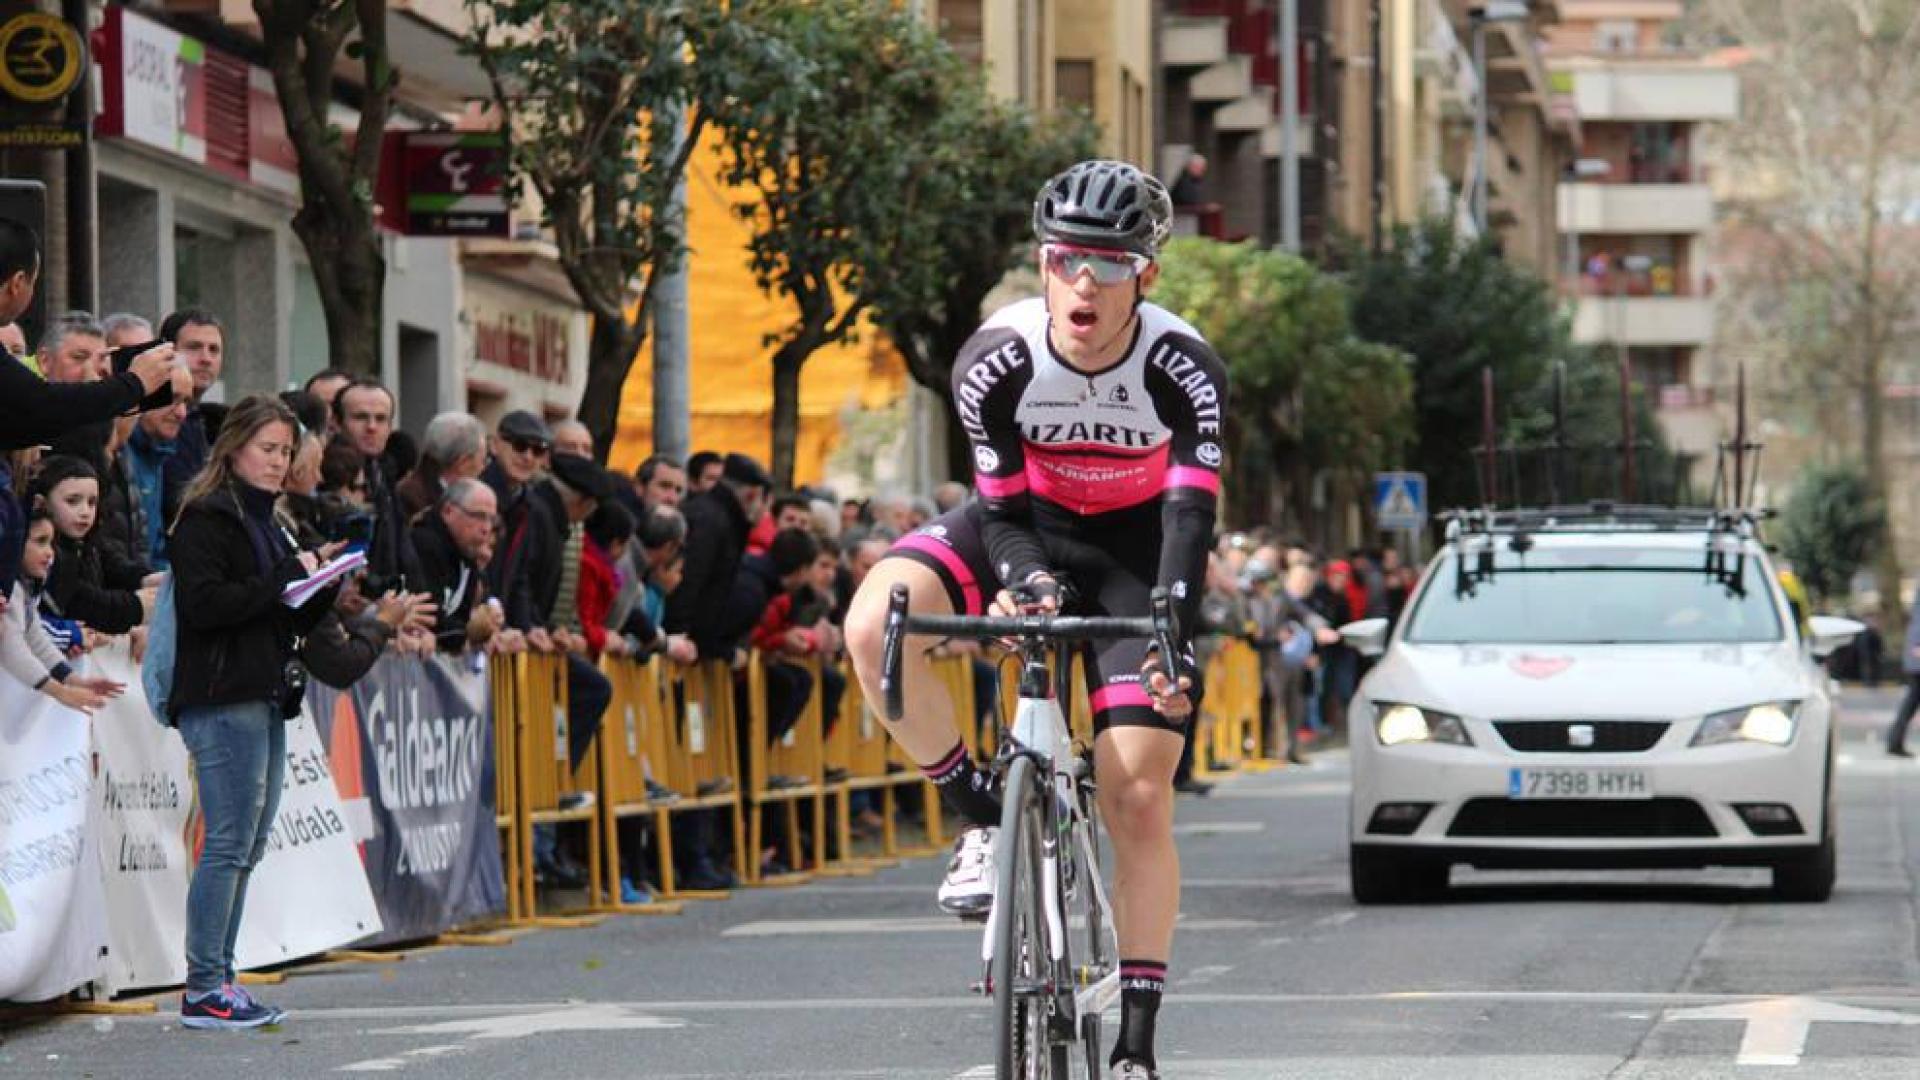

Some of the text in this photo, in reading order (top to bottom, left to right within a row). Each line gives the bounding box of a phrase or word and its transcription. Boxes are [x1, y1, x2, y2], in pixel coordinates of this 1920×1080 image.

[960, 340, 1025, 440] LIZARTE
[1151, 343, 1221, 436] LIZARTE
[1016, 421, 1158, 447] IZARTE
[1527, 772, 1645, 795] 7398 HYH
[278, 805, 345, 848] Udala
